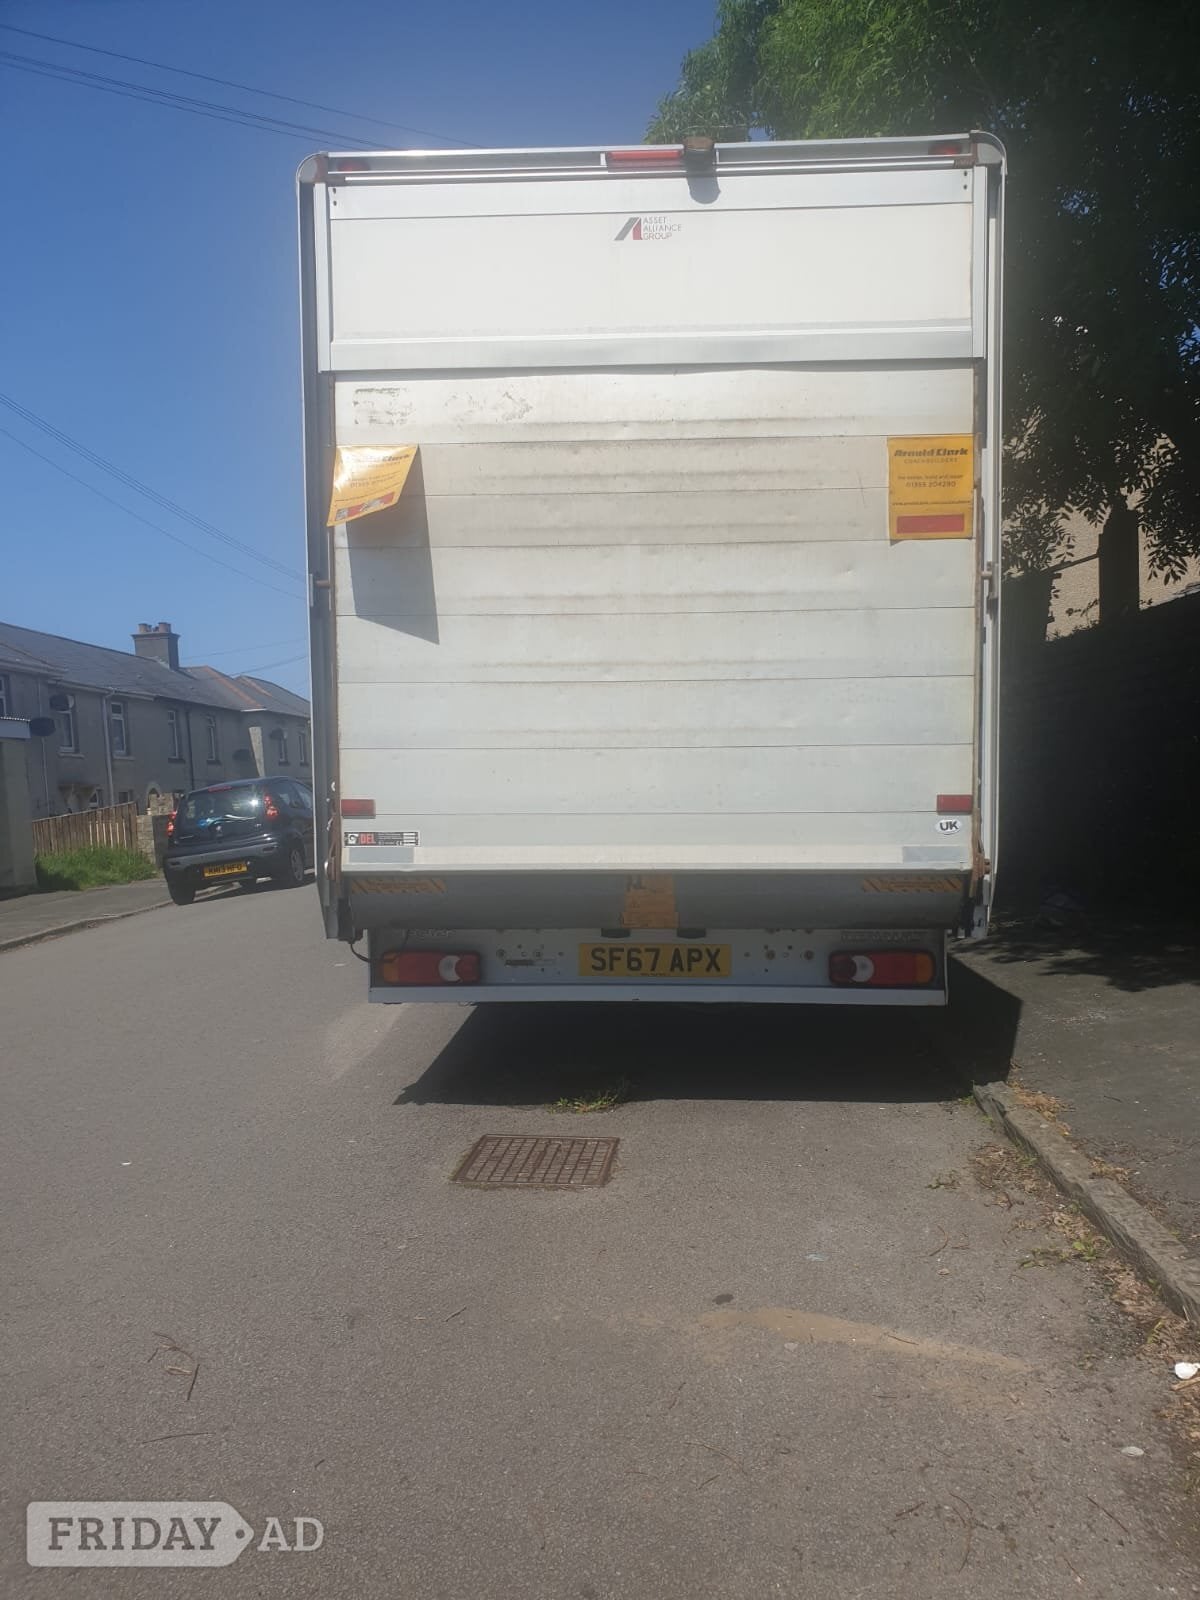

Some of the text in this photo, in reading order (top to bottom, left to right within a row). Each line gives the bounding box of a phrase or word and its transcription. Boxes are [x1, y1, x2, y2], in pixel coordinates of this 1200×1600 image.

[643, 216, 667, 224] ASSET
[643, 224, 682, 232] ALLIANCE
[643, 232, 673, 240] GROUP
[936, 447, 969, 456] Clark
[940, 820, 959, 831] UK
[591, 946, 721, 973] SF67 APX
